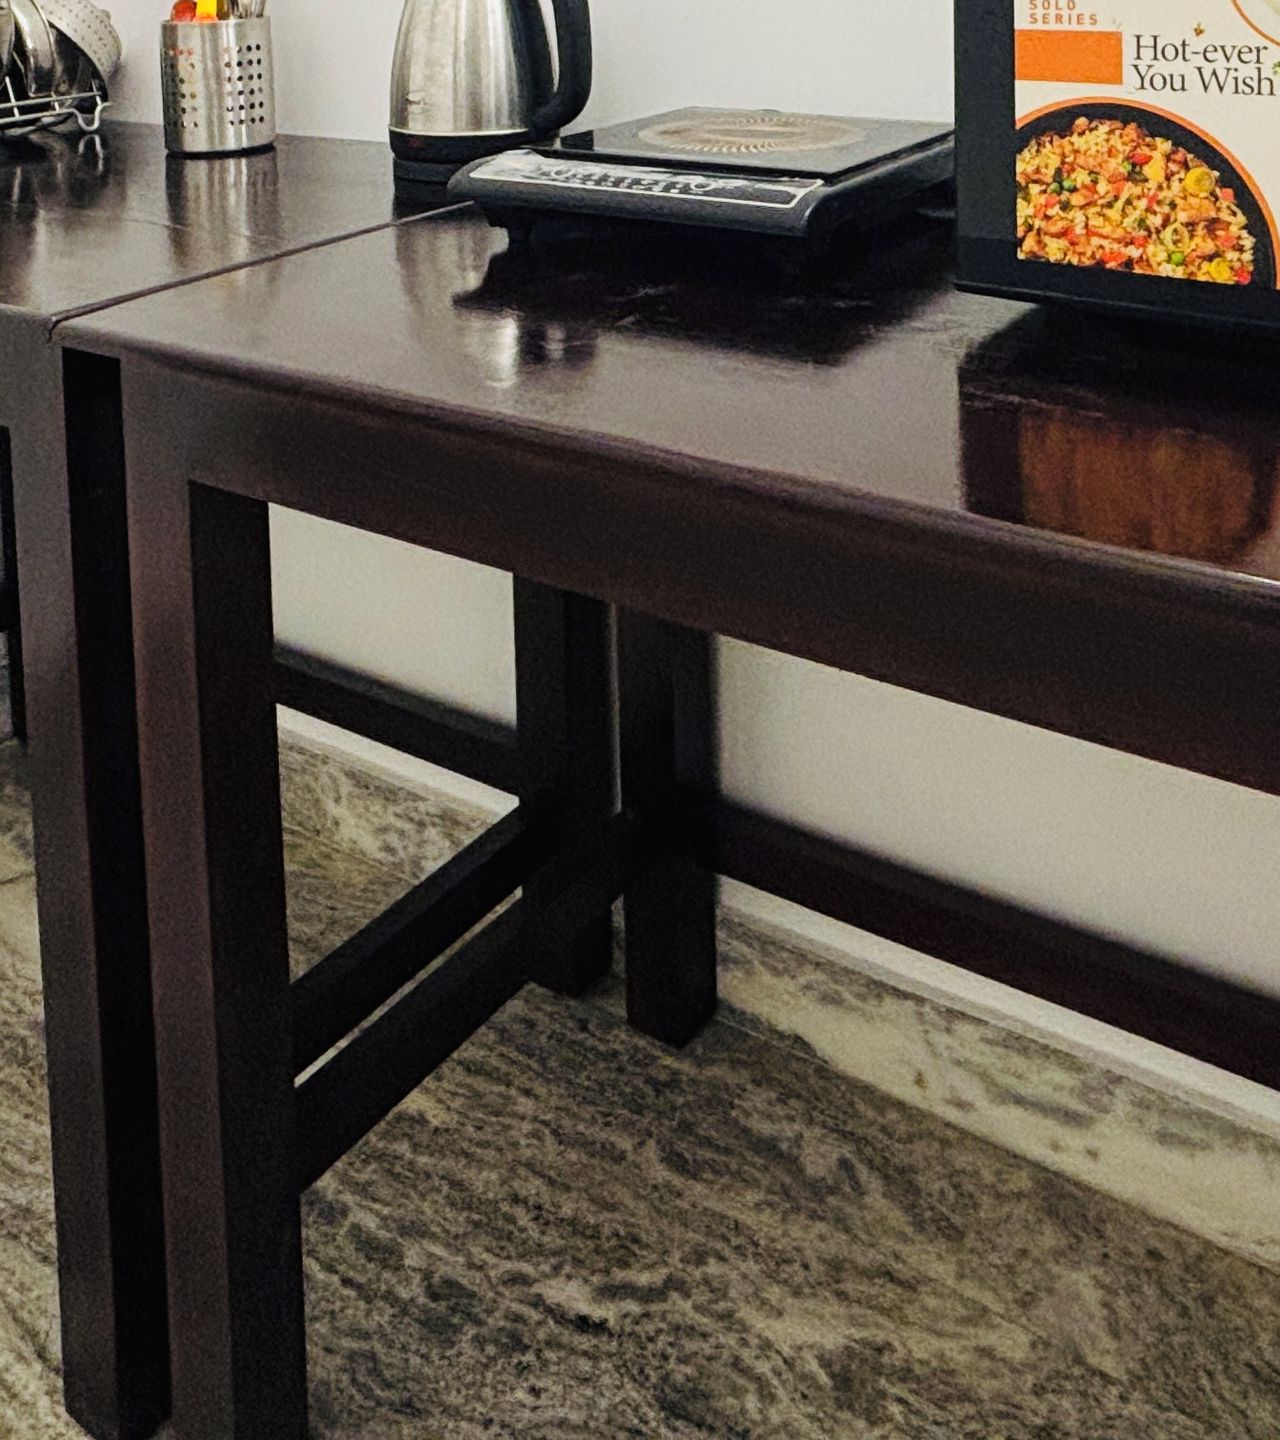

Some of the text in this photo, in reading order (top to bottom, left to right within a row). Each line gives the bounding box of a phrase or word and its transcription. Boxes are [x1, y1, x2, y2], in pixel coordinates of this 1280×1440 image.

[1029, 13, 1098, 26] SERIES
[1133, 34, 1269, 65] Hot-ever
[1130, 64, 1276, 97] You Wish
